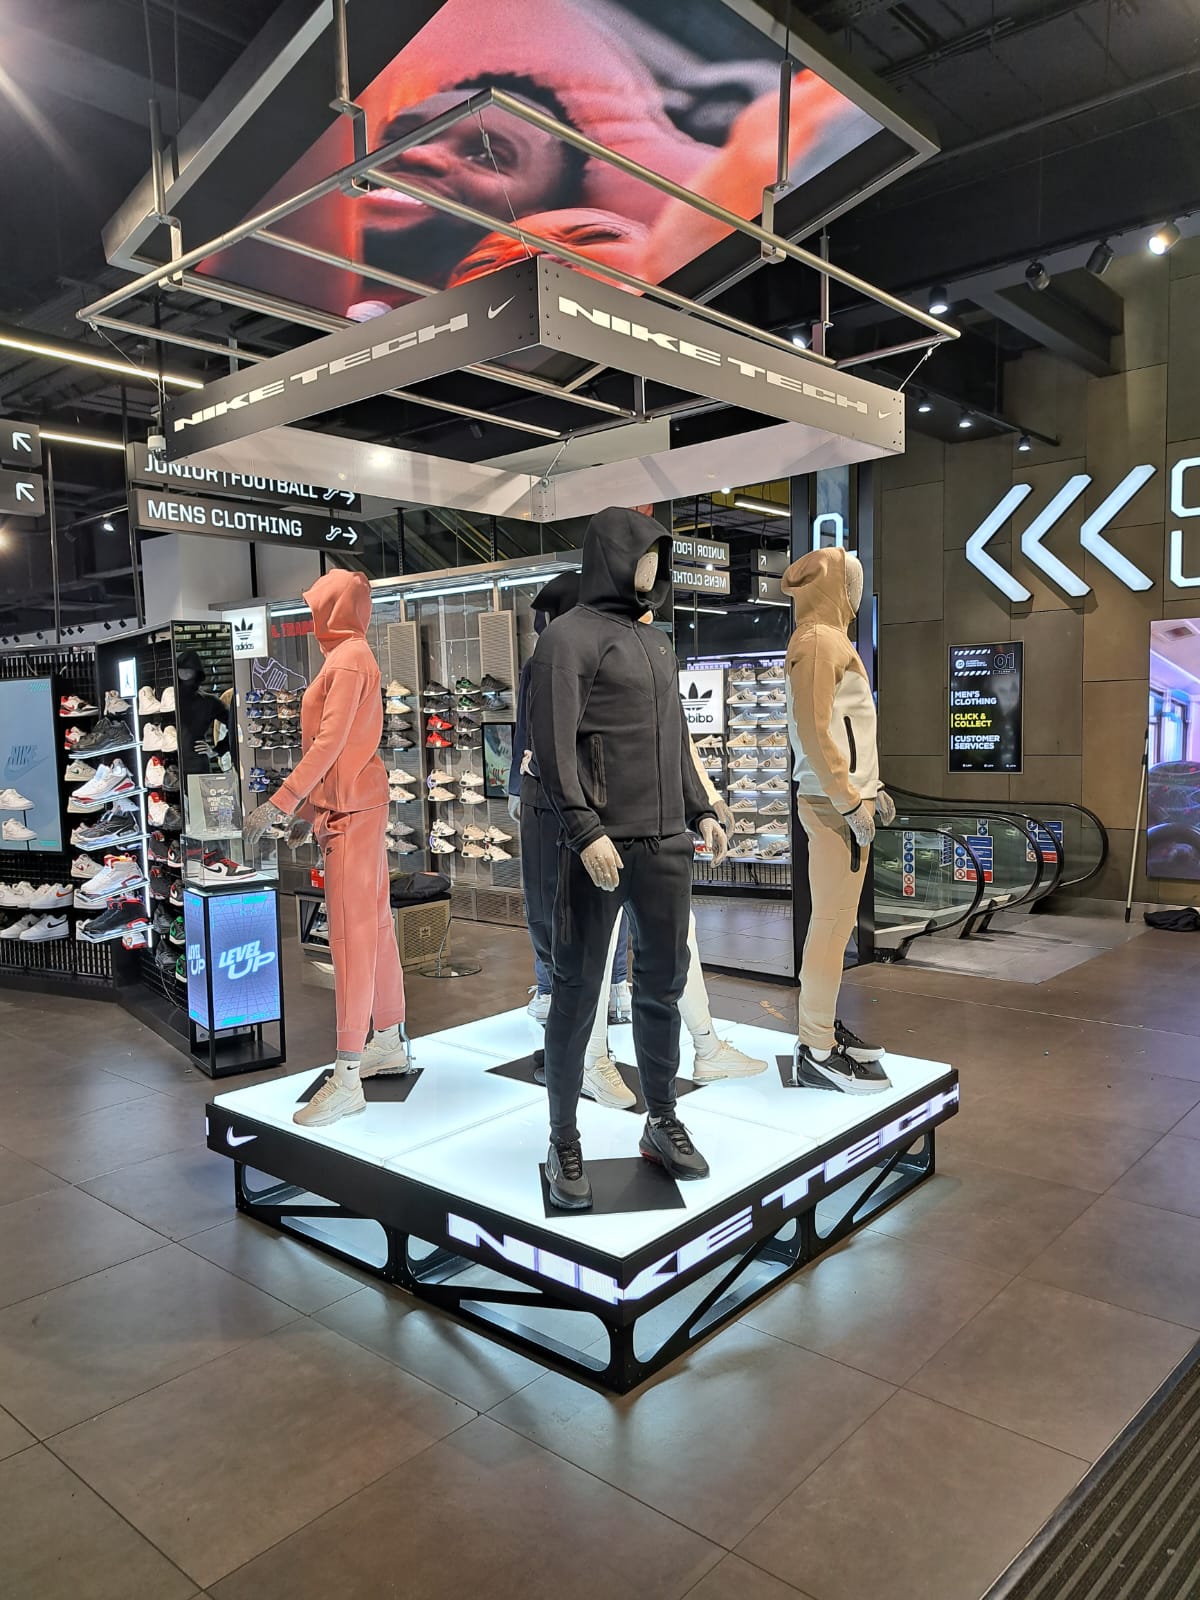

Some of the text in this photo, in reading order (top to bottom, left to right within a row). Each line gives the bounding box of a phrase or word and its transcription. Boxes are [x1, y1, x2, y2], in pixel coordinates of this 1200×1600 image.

[558, 296, 868, 415] NIKE TECH
[174, 312, 469, 432] NIKE TECH
[145, 454, 219, 483] JUNIOR
[148, 500, 303, 537] MENS CLOTHING
[235, 642, 254, 651] adidas
[955, 690, 980, 698] MEN'S
[955, 698, 997, 706] CLOTHING
[954, 720, 992, 728] COLLECT
[955, 735, 1000, 743] CUSTOMER
[219, 940, 261, 968] LEVEL
[191, 959, 206, 975] UP
[228, 952, 276, 980] UP
